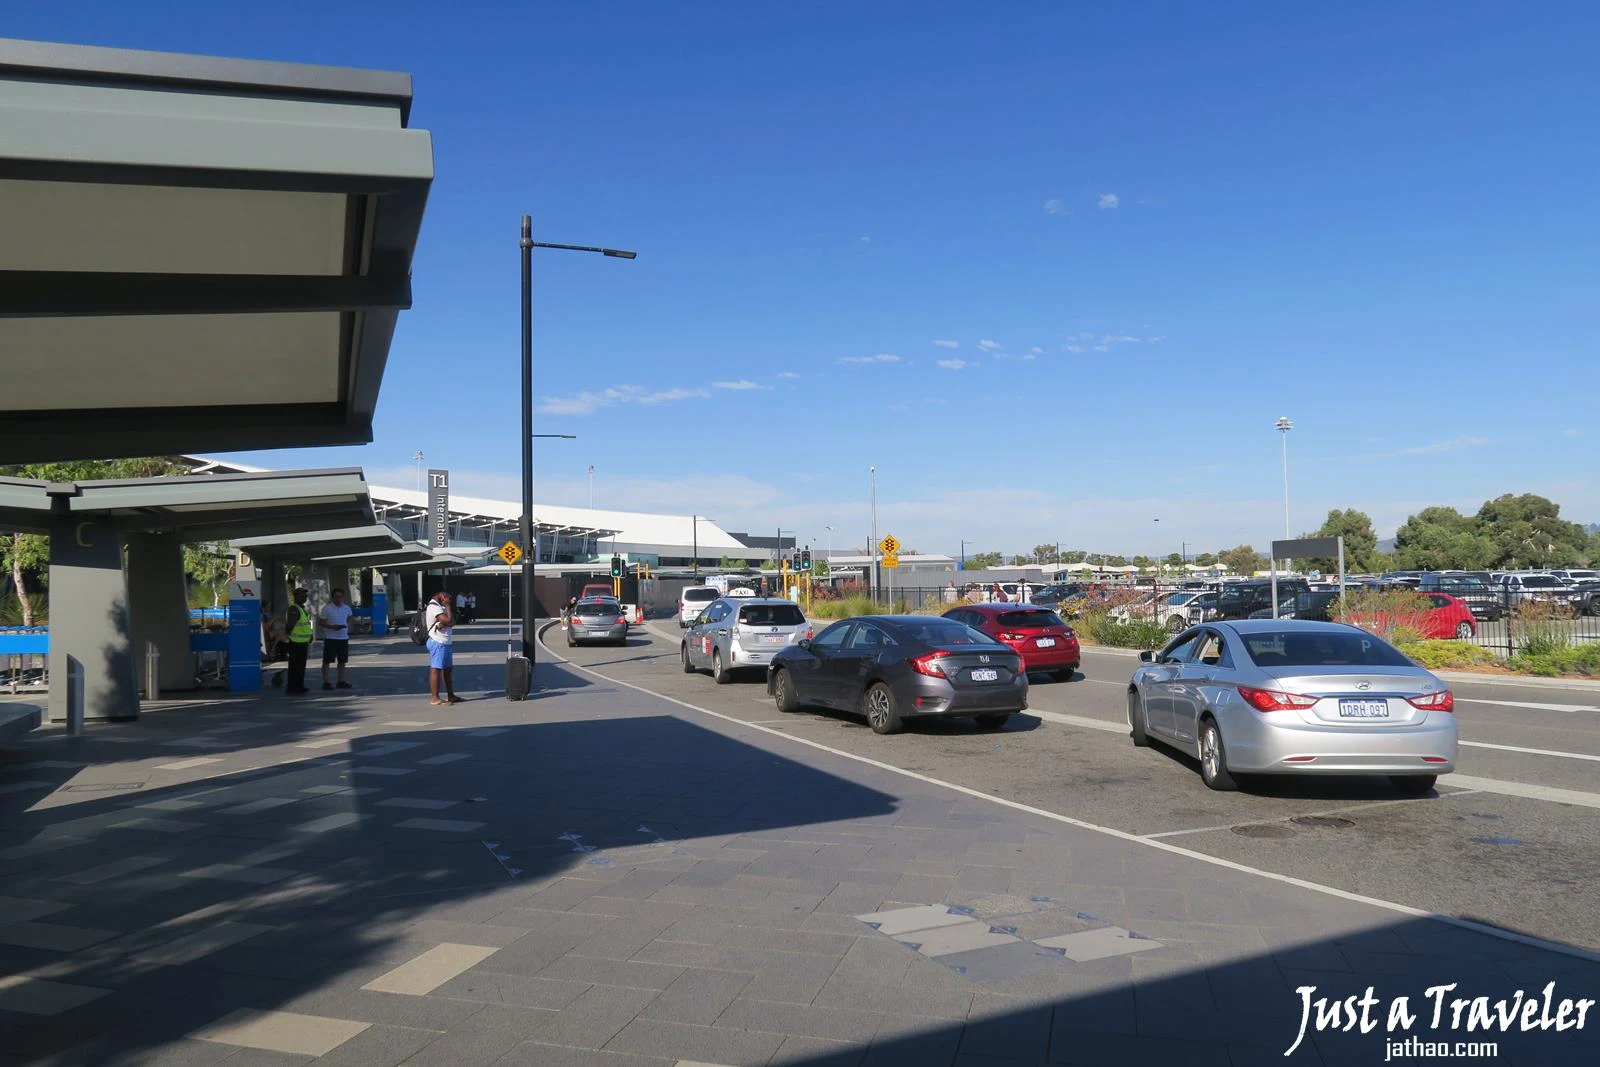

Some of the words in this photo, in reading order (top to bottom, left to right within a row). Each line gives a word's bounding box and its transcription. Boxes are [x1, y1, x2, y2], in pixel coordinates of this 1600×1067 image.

[429, 473, 448, 488] T1
[76, 522, 96, 548] C
[239, 551, 251, 567] D
[1361, 639, 1371, 653] P
